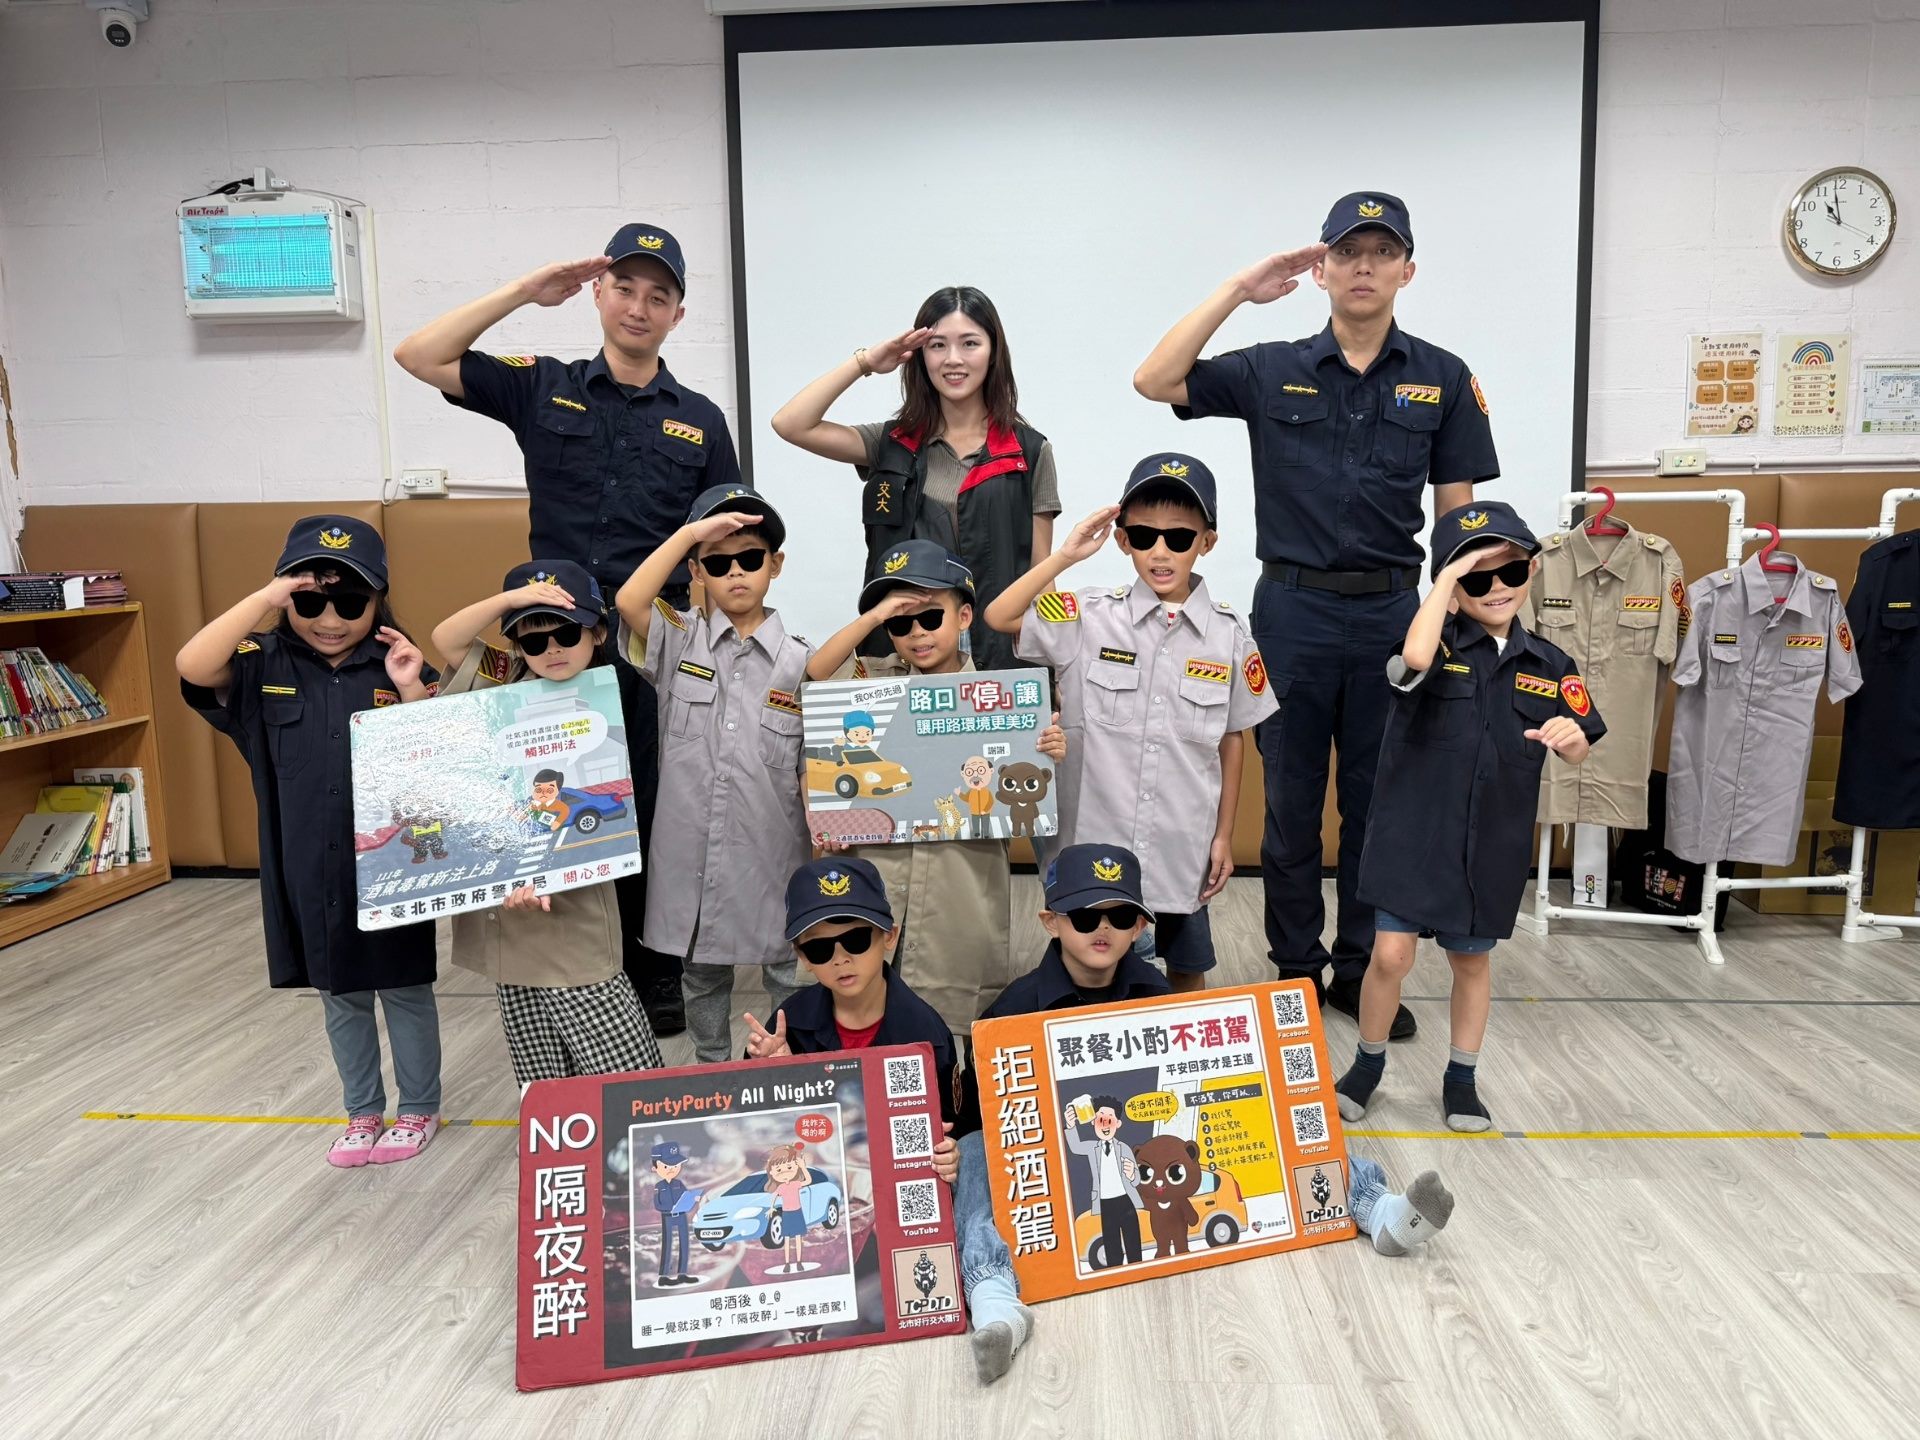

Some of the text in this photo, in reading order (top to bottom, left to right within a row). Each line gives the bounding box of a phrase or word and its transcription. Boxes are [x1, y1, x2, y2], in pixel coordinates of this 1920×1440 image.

[1816, 187, 1828, 197] 11
[1858, 184, 1864, 195] 1
[1801, 201, 1816, 211] 10
[1869, 198, 1878, 208] 2
[1794, 220, 1803, 230] 9
[1874, 216, 1882, 226] 3
[1800, 238, 1808, 248] 8
[1866, 235, 1875, 245] 4
[1815, 251, 1823, 261] 7
[1853, 250, 1861, 260] 5
[1832, 256, 1841, 266] 6
[876, 481, 891, 513] 交大
[854, 684, 903, 704] 我OK你先過
[910, 682, 1039, 711] 路口「停」讓
[916, 714, 1036, 735] 讓用路環境更美好
[524, 739, 577, 758] 觸犯刑法
[563, 864, 611, 885] 關心您
[1278, 1029, 1310, 1039] Facebook
[1056, 1015, 1251, 1068] 聚餐小酌不酒駕
[1166, 1052, 1255, 1077] 平安回家才是王道
[1287, 1085, 1320, 1096] Instagram
[631, 1079, 835, 1117] PartyParty All Night?
[888, 1098, 927, 1108] Facebook
[802, 1118, 827, 1127] 我昨天
[802, 1128, 827, 1137] 喝的啊
[990, 1045, 1058, 1257] 拒絕酒駕
[1300, 1145, 1329, 1155] YouTube
[529, 1112, 596, 1339] NO 隔夜醉
[903, 1227, 939, 1237] YouTube
[710, 1294, 751, 1311] 喝酒後
[898, 1314, 960, 1330] 北市好行交大隨行
